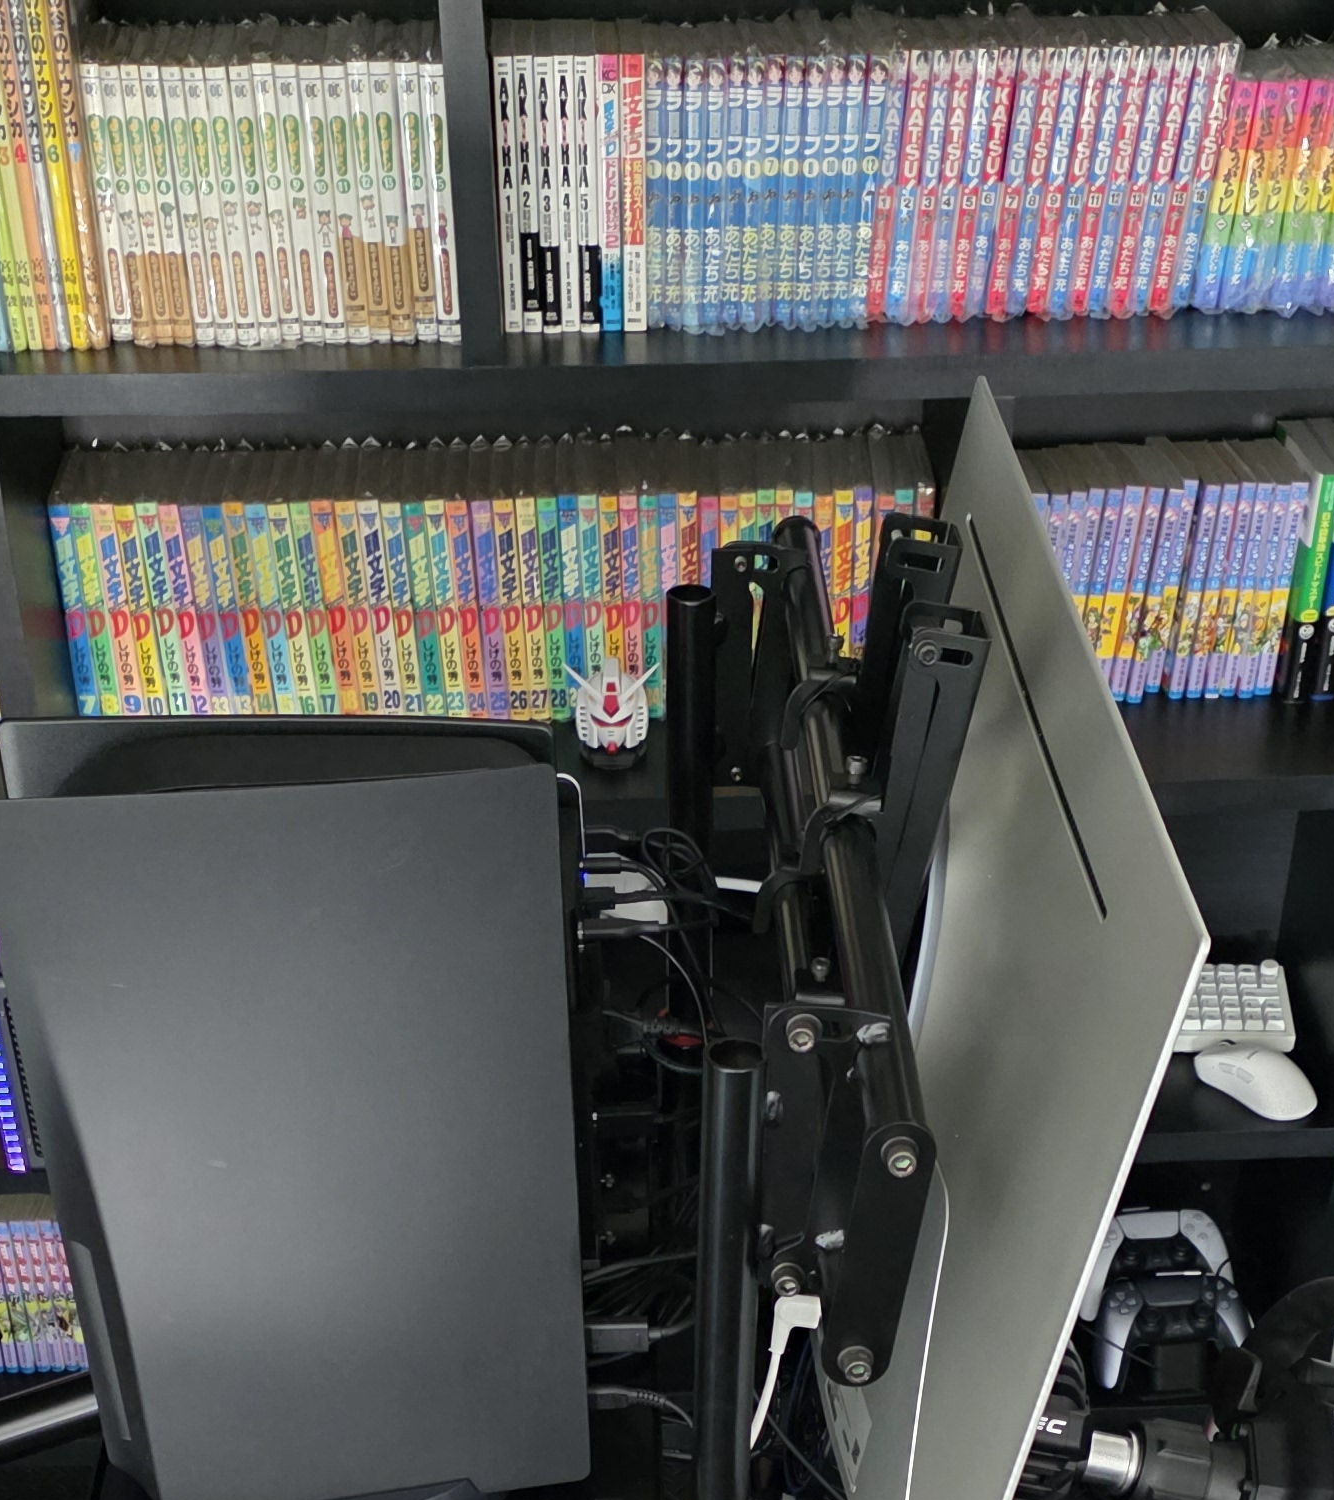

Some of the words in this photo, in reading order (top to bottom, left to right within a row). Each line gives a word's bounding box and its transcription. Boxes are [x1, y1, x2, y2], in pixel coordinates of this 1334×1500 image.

[601, 83, 616, 95] DX
[499, 77, 513, 189] AKIRA
[518, 73, 531, 185] AKIRA
[538, 77, 551, 189] AKIRA
[559, 75, 571, 187] AKIRA
[577, 75, 589, 188] AKIRA
[983, 87, 1010, 190] KATSU!
[1049, 87, 1079, 191] KATSU!
[1111, 87, 1144, 190] KATSU!
[1153, 87, 1186, 191] KATSU!
[1175, 87, 1207, 189] KATSU!
[1196, 85, 1227, 187] KATSU!
[880, 91, 901, 194] KATSU!
[902, 90, 926, 195] KATSU!
[943, 88, 967, 193] KATSU!
[965, 89, 989, 193] KATSU!
[1007, 89, 1035, 192] KATSU!
[1028, 89, 1057, 193] KATSU!
[1091, 88, 1122, 191] KATSU!
[14, 144, 27, 163] 4
[48, 144, 60, 163] 6
[68, 143, 81, 163] 7
[505, 195, 511, 212] 1
[522, 191, 531, 208] 2
[543, 195, 551, 212] 3
[563, 193, 571, 210] 4
[580, 193, 589, 210] 5
[79, 696, 96, 713] 7
[124, 695, 142, 713] 9
[191, 695, 208, 713] 12
[321, 694, 336, 712] 17
[362, 692, 379, 711] 19
[384, 690, 401, 708] 20
[447, 692, 464, 711] 23
[510, 690, 527, 709] 26
[531, 689, 548, 709] 27
[551, 689, 566, 707] 28
